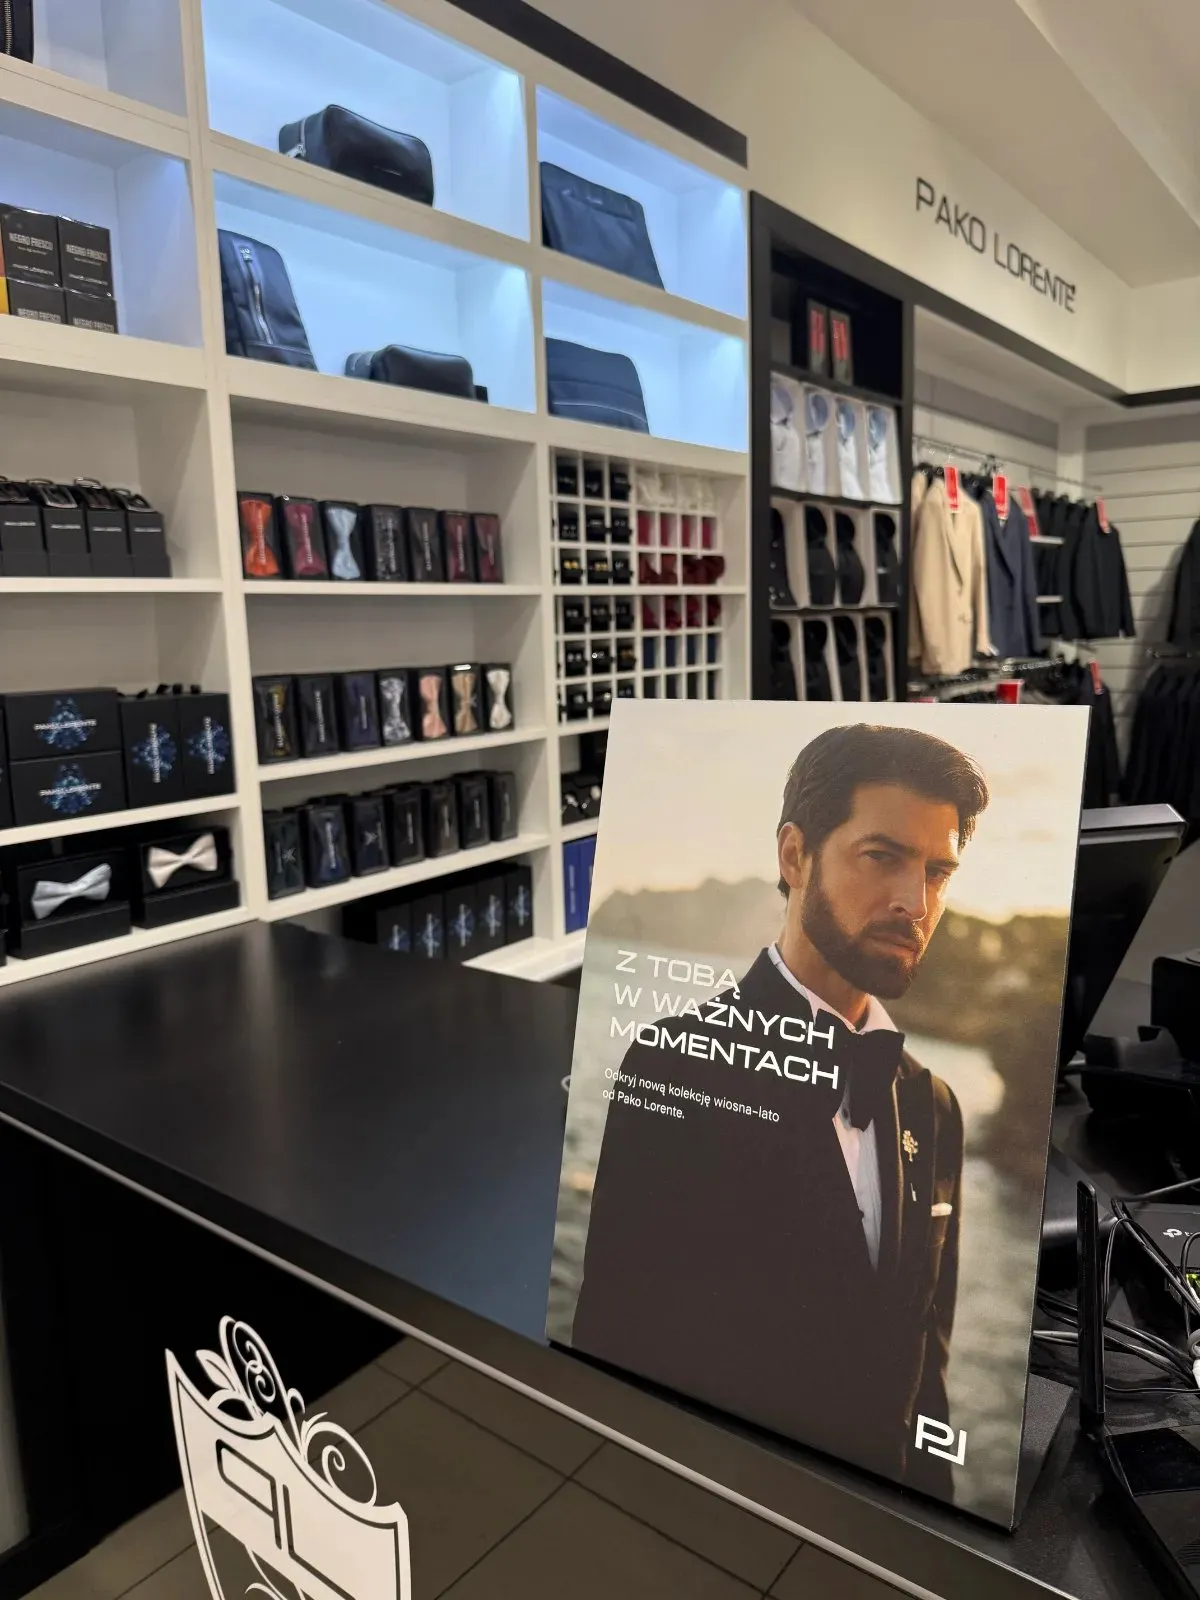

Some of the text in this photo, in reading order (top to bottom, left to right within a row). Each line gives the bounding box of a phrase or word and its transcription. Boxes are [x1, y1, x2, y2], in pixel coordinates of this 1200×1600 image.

[915, 176, 1076, 313] PAKO LORENTE
[615, 950, 741, 1000] Z TOBĄ
[614, 983, 835, 1050] W WAŻNYCH
[609, 1016, 840, 1090] MOMENTACH
[602, 1089, 685, 1119] od Pako Lorente.
[604, 1067, 637, 1088] Odkryj
[639, 1078, 666, 1096] nową
[668, 1082, 711, 1108] kolekcję
